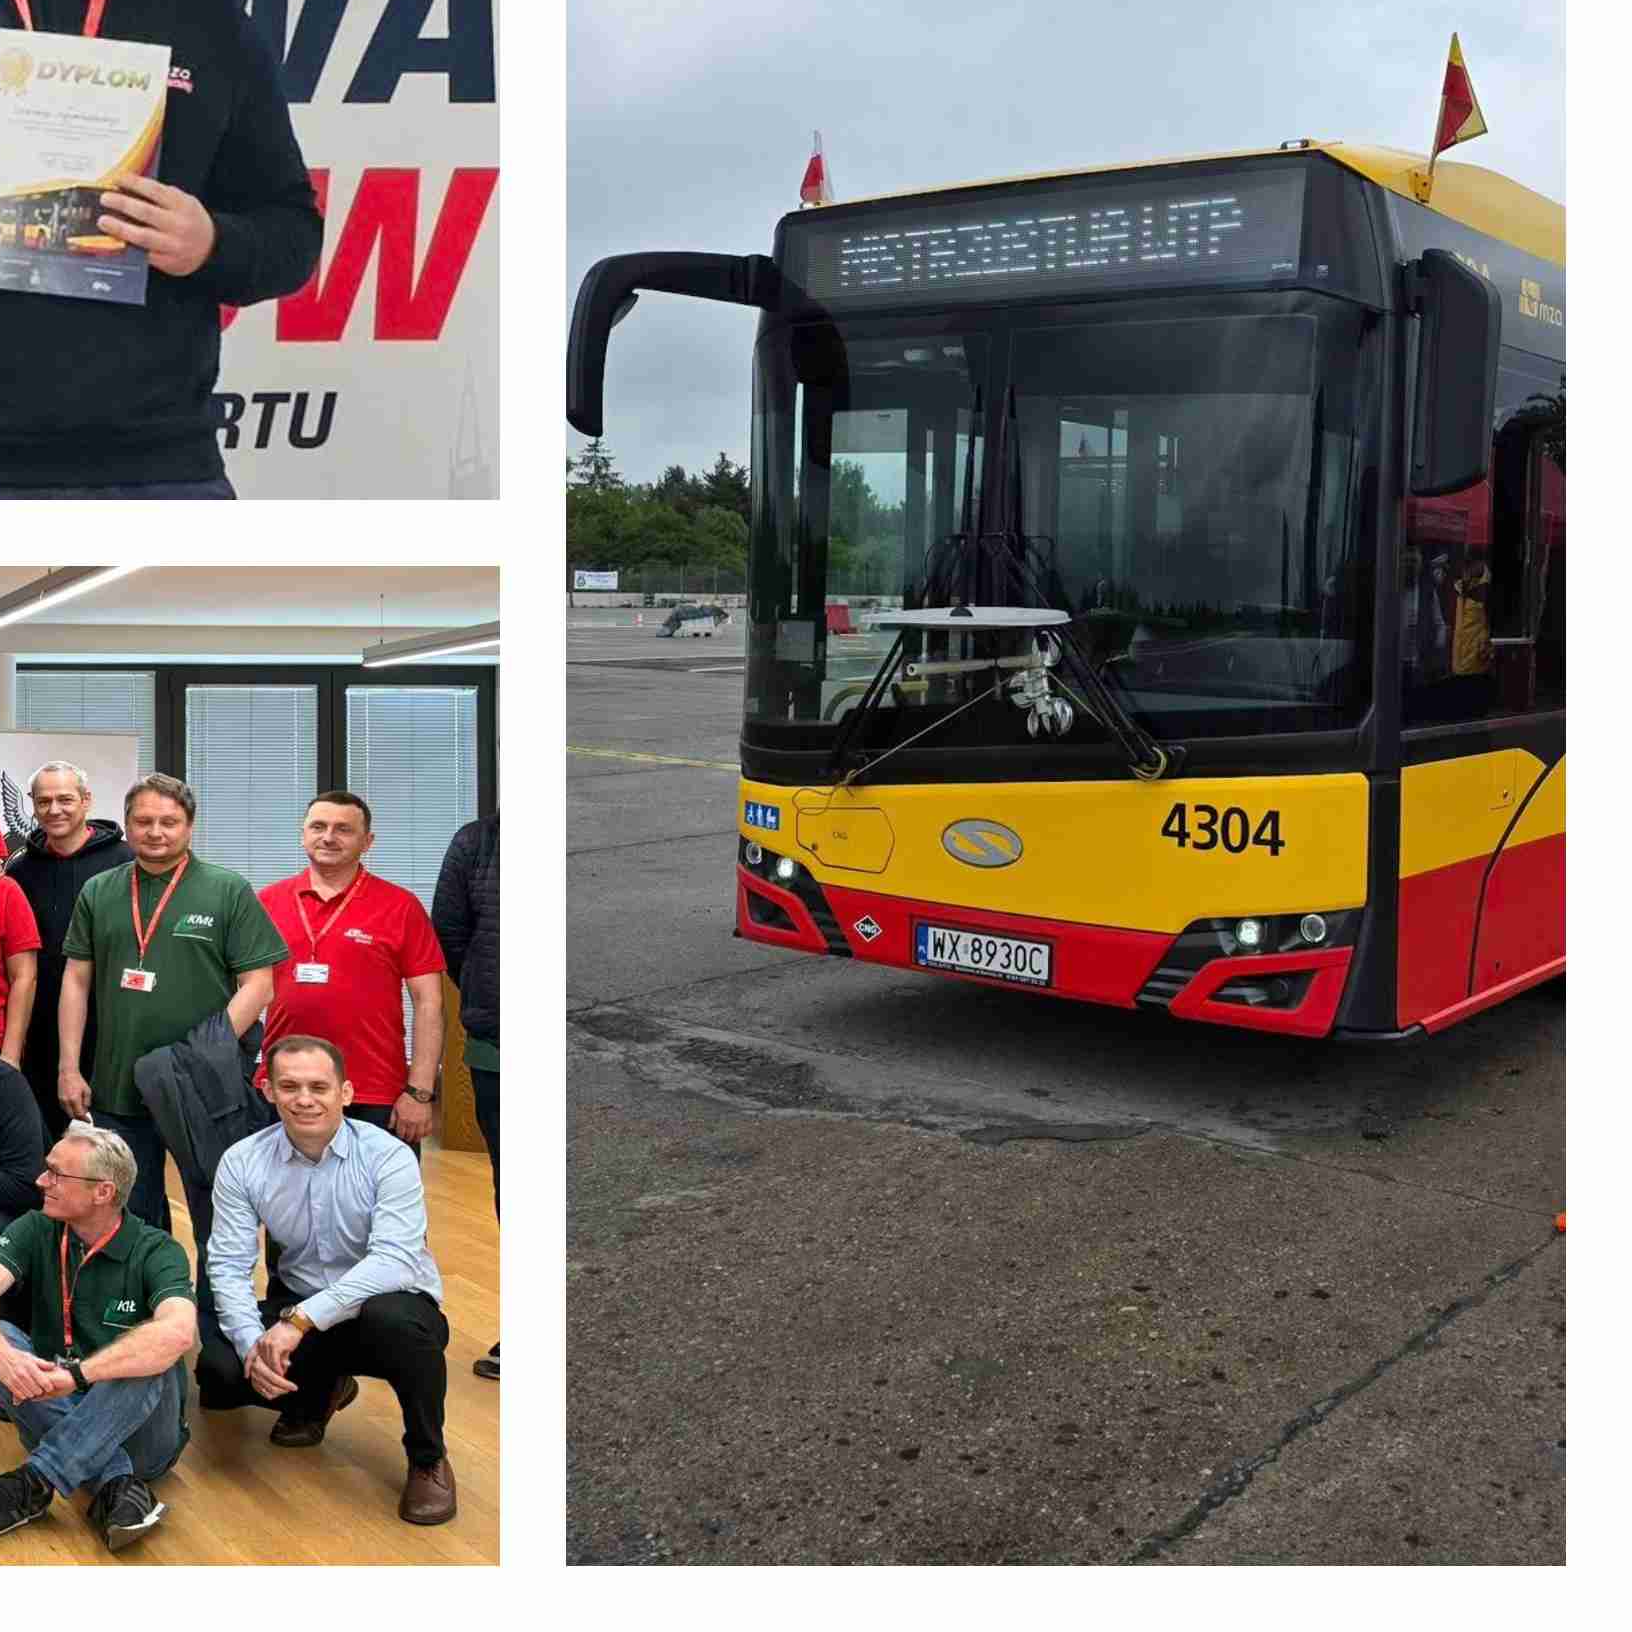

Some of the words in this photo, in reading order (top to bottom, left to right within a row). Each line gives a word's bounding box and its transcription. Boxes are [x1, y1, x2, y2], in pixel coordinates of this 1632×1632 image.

[37, 62, 151, 91] DYPLOM
[1161, 800, 1286, 856] 4304
[857, 923, 879, 934] CNG
[932, 930, 961, 962] WX
[970, 937, 1043, 975] 8930C
